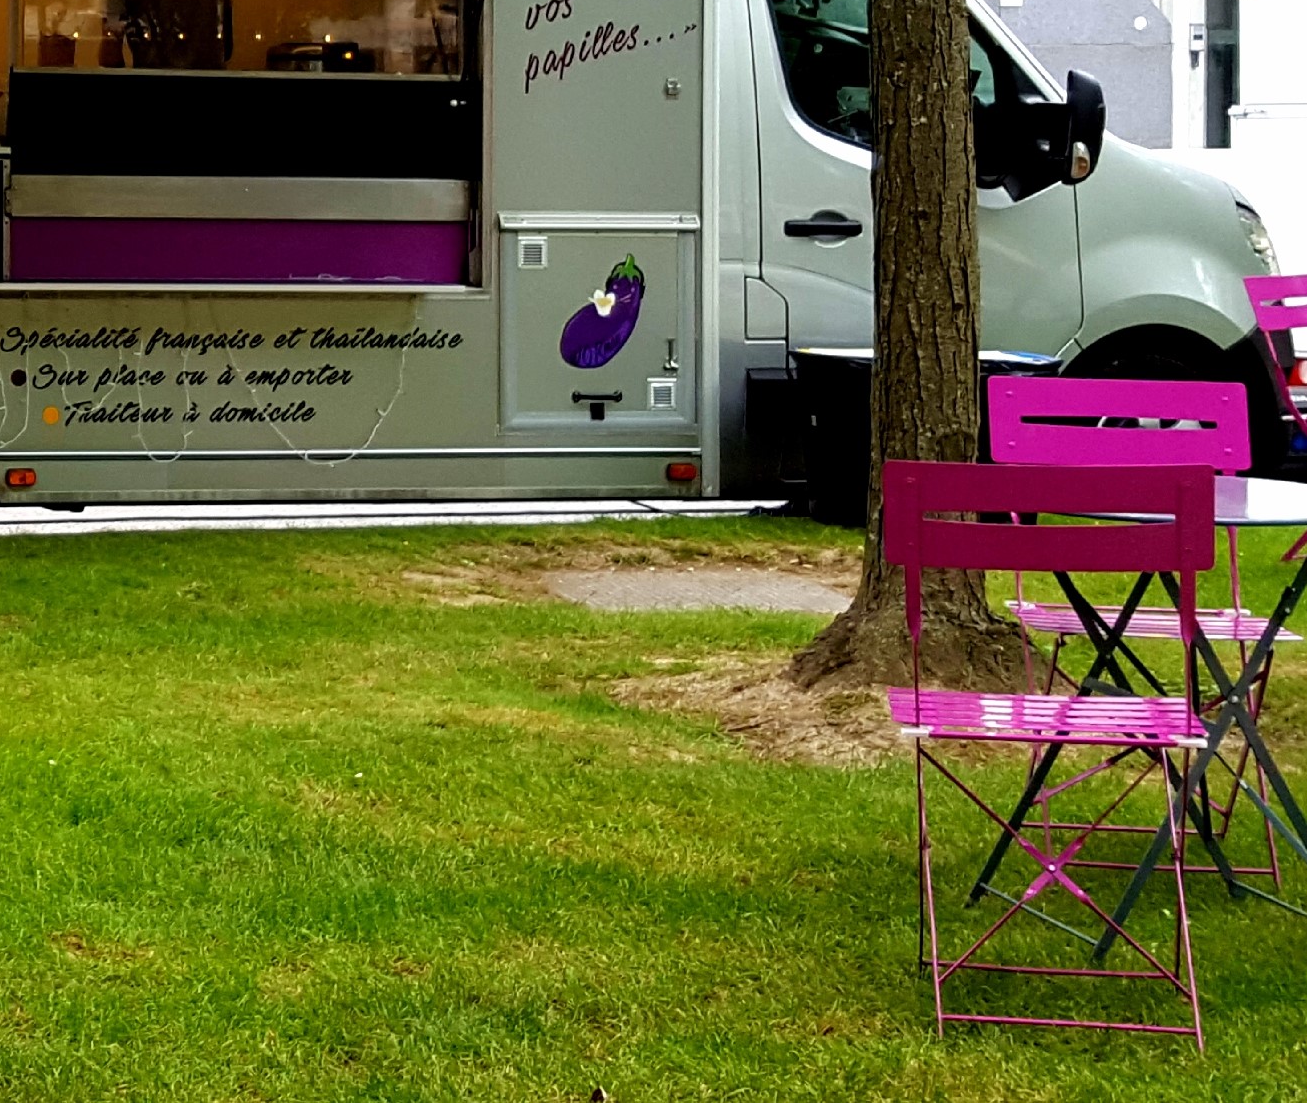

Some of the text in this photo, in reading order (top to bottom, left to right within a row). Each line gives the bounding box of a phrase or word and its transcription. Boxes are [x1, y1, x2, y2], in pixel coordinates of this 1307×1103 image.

[0, 326, 463, 357] Spécialité française et thaïlandaise
[32, 363, 354, 392] Sur place ou à emporter
[62, 401, 317, 427] Traiteur à domicile
